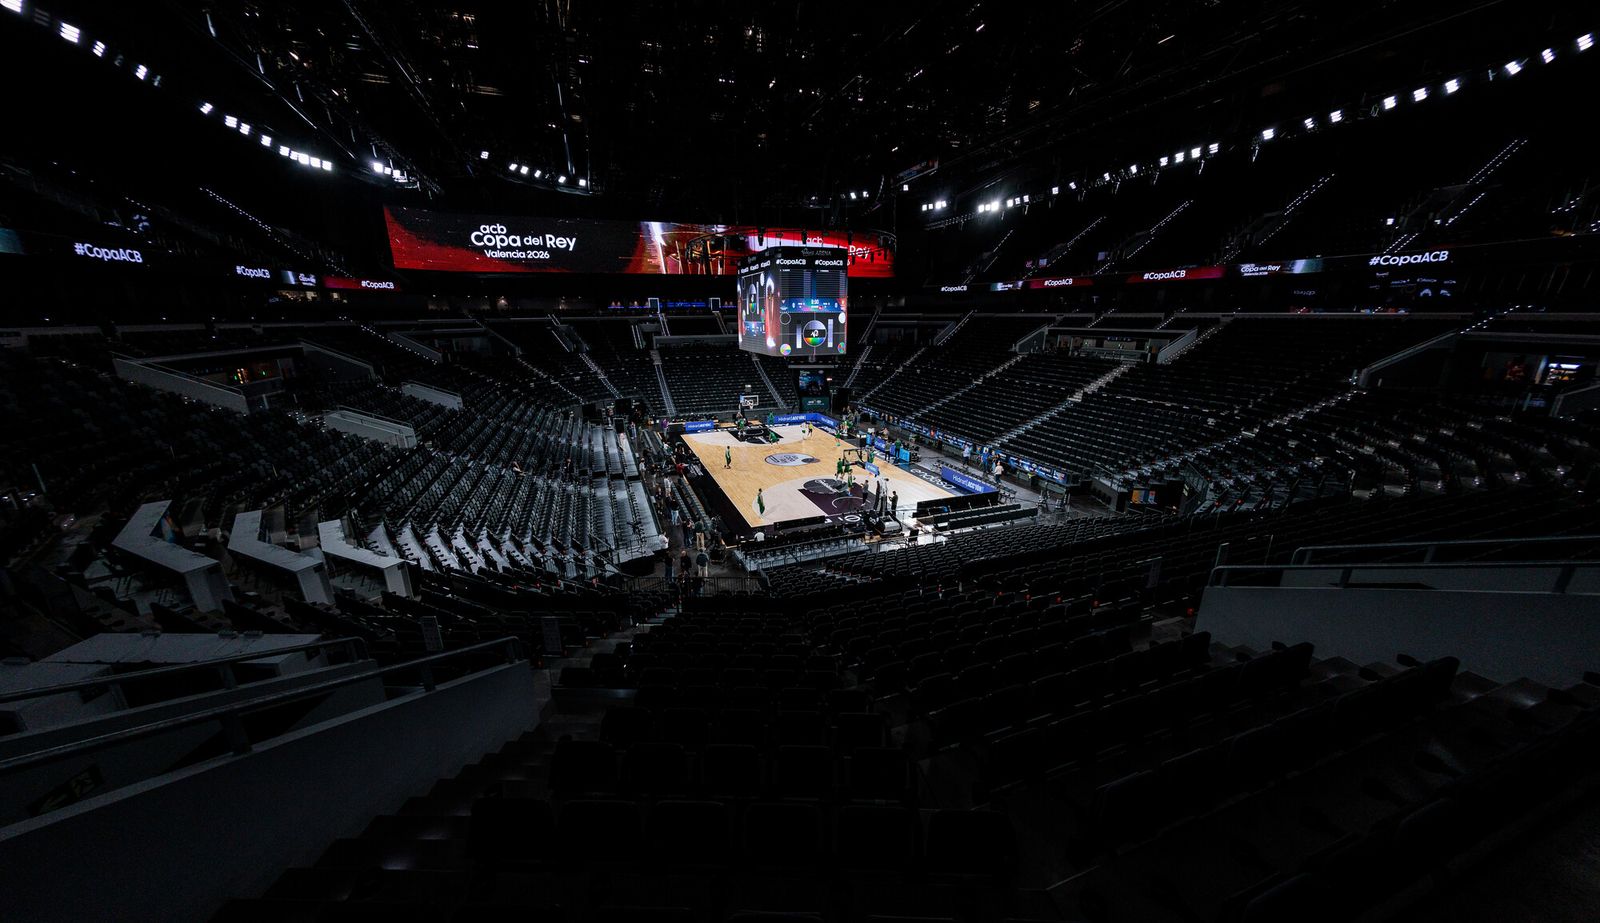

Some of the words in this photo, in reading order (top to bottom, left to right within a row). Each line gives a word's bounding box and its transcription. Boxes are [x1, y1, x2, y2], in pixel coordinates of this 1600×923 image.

[480, 224, 507, 234] acb
[470, 231, 521, 249] Copa
[523, 236, 543, 246] del
[545, 234, 576, 251] Rey
[74, 242, 143, 263] #CopaACB
[484, 249, 526, 259] Valencia
[526, 250, 550, 259] 2026
[775, 258, 807, 266] #CopaACB
[1368, 251, 1449, 266] #CopaACB
[235, 265, 271, 279] #CopaACB
[1143, 270, 1187, 281] #CopaACB
[359, 279, 395, 290] #CopaACB
[1044, 278, 1073, 286] #CopaACB
[940, 284, 968, 293] #CopaACB
